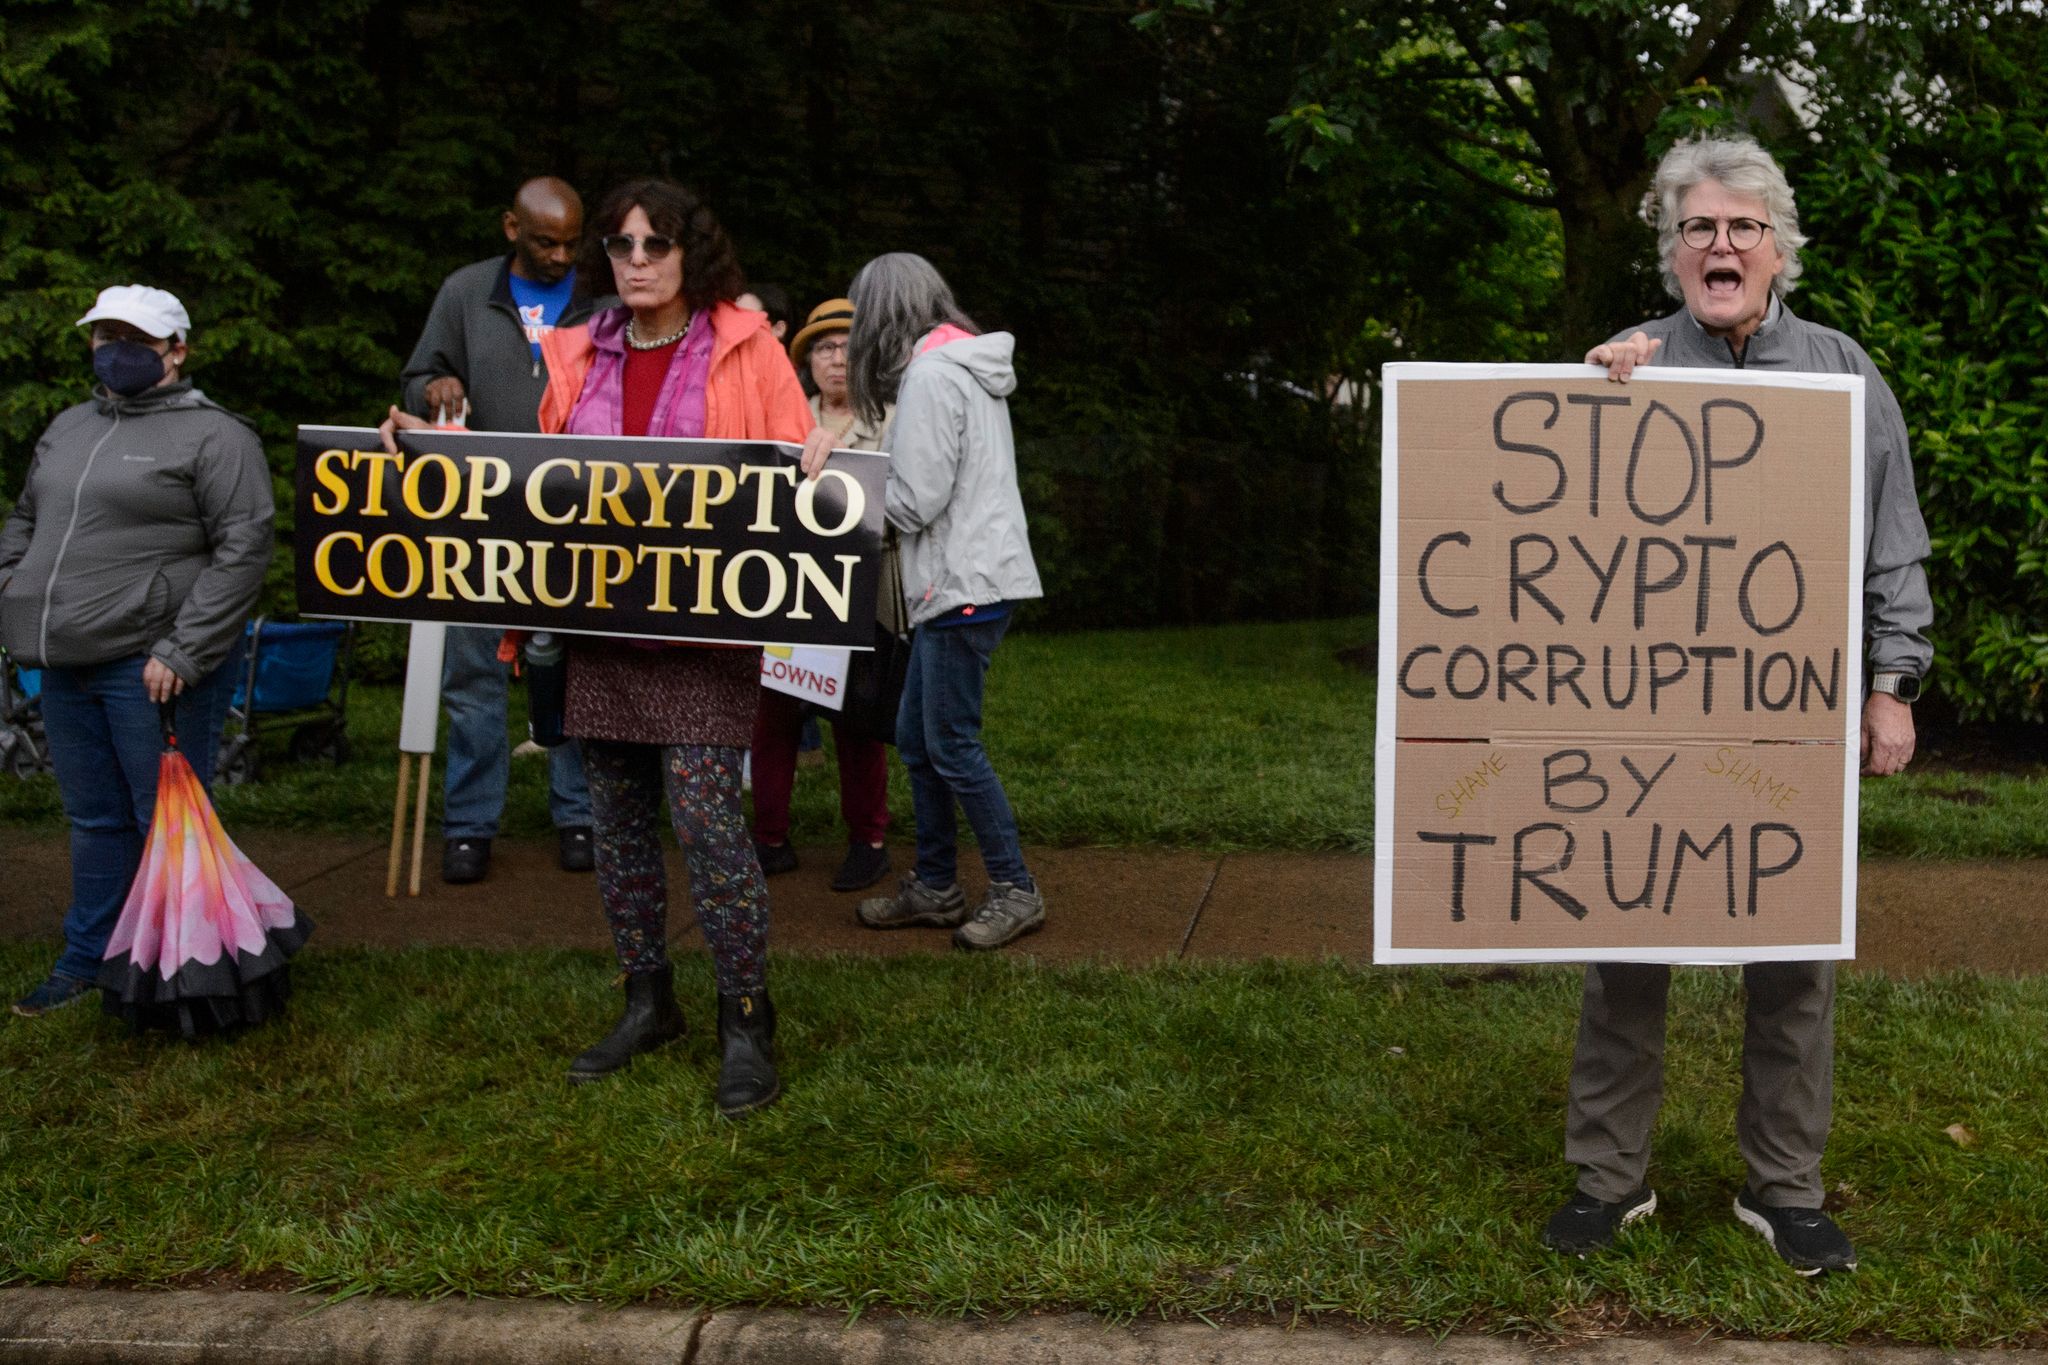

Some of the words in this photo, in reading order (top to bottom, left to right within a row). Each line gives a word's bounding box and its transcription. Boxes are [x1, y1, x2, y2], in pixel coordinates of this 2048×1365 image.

[312, 448, 512, 522] STOP
[525, 457, 866, 538] CRYPTO
[1492, 391, 1765, 526] STOP
[313, 530, 862, 624] CORRUPTION
[1417, 530, 1806, 637] CRYPTO
[760, 655, 838, 697] LOWNS
[1397, 643, 1840, 716] CORRUPTION
[1435, 751, 1509, 820] SHAME
[1542, 748, 1677, 818] BY
[1704, 746, 1801, 813] SHAME
[1416, 821, 1804, 925] TRUMP
